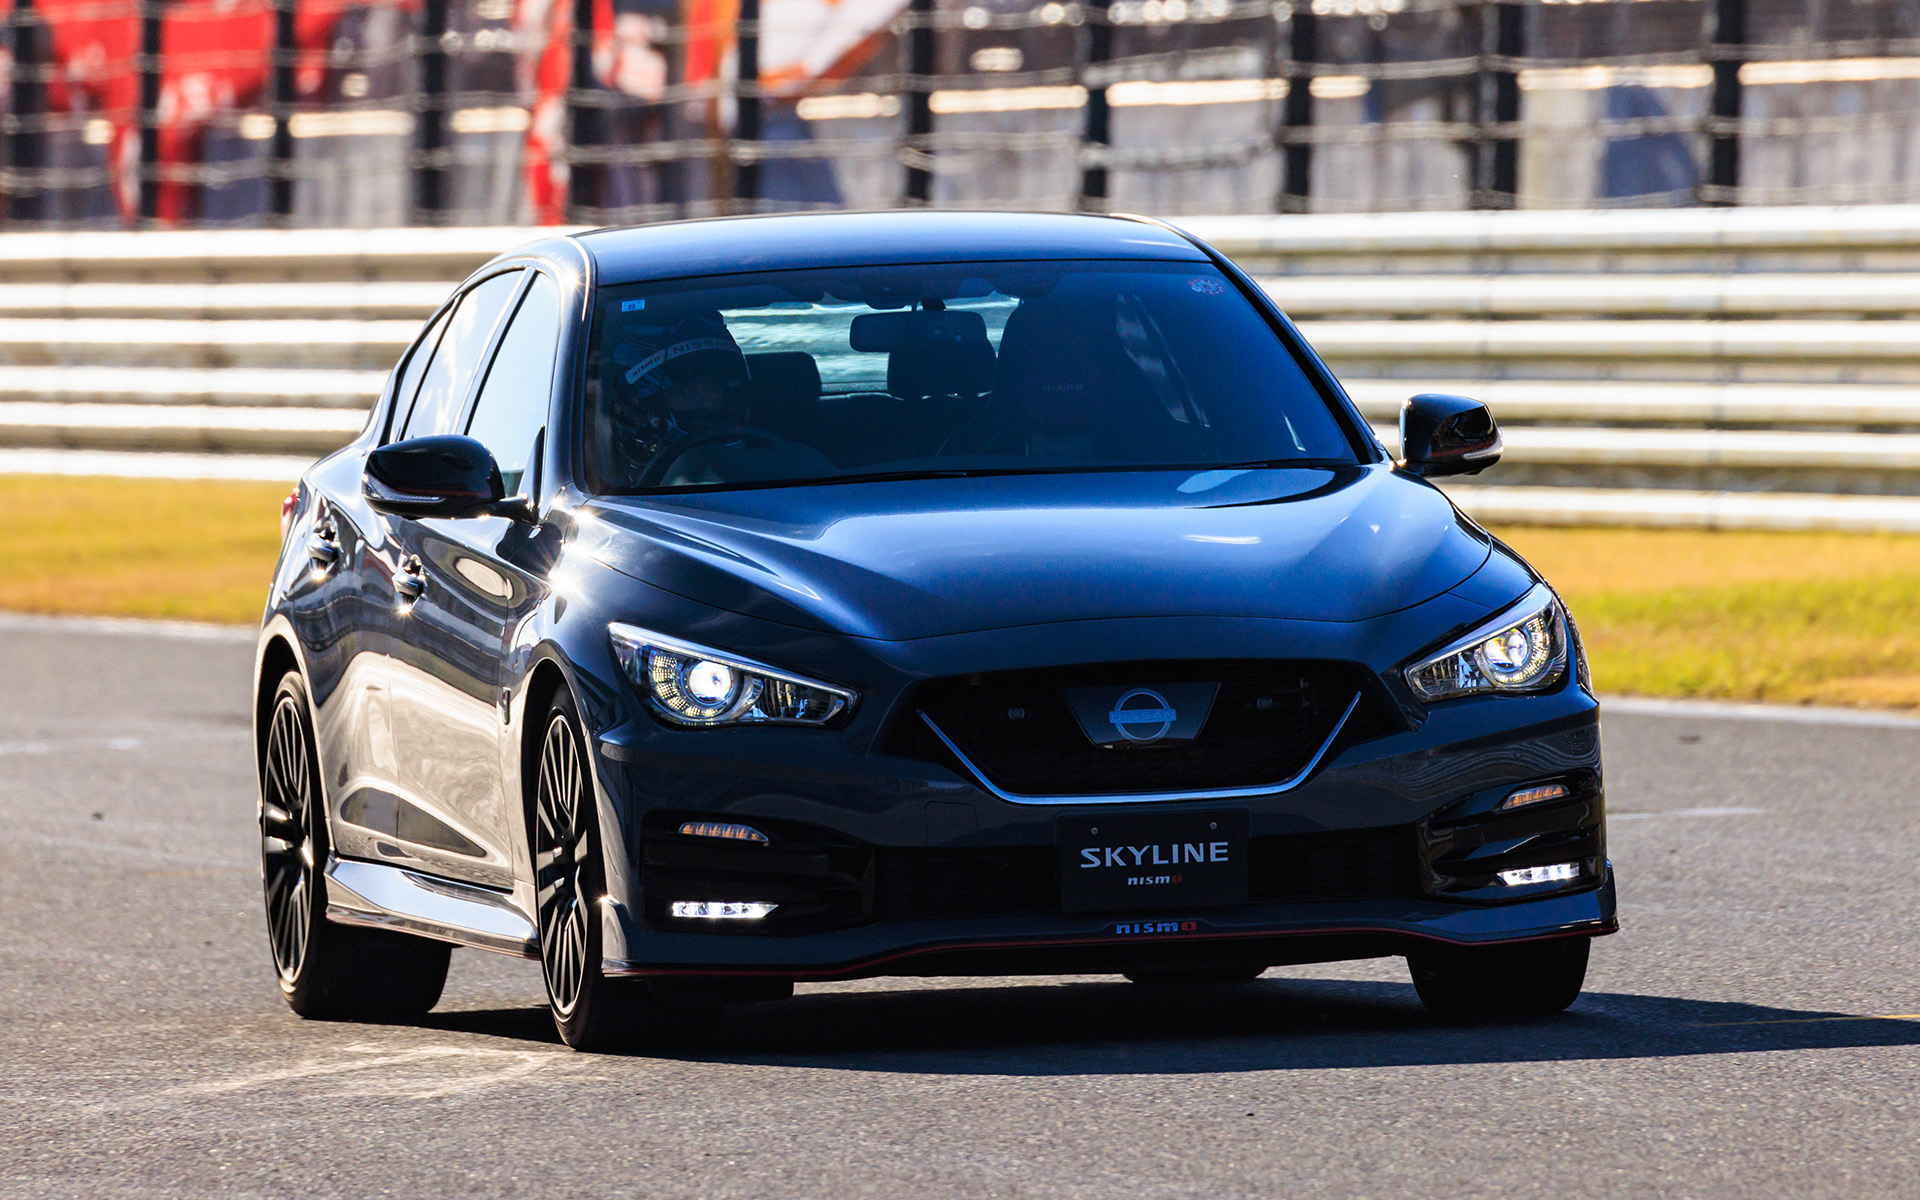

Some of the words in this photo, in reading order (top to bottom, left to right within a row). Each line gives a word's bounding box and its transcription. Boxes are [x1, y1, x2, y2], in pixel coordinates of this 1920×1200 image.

[1111, 711, 1175, 721] NISSAN
[1080, 841, 1229, 869] SKYLINE
[1127, 875, 1182, 886] nismo
[1116, 921, 1197, 935] nismo
